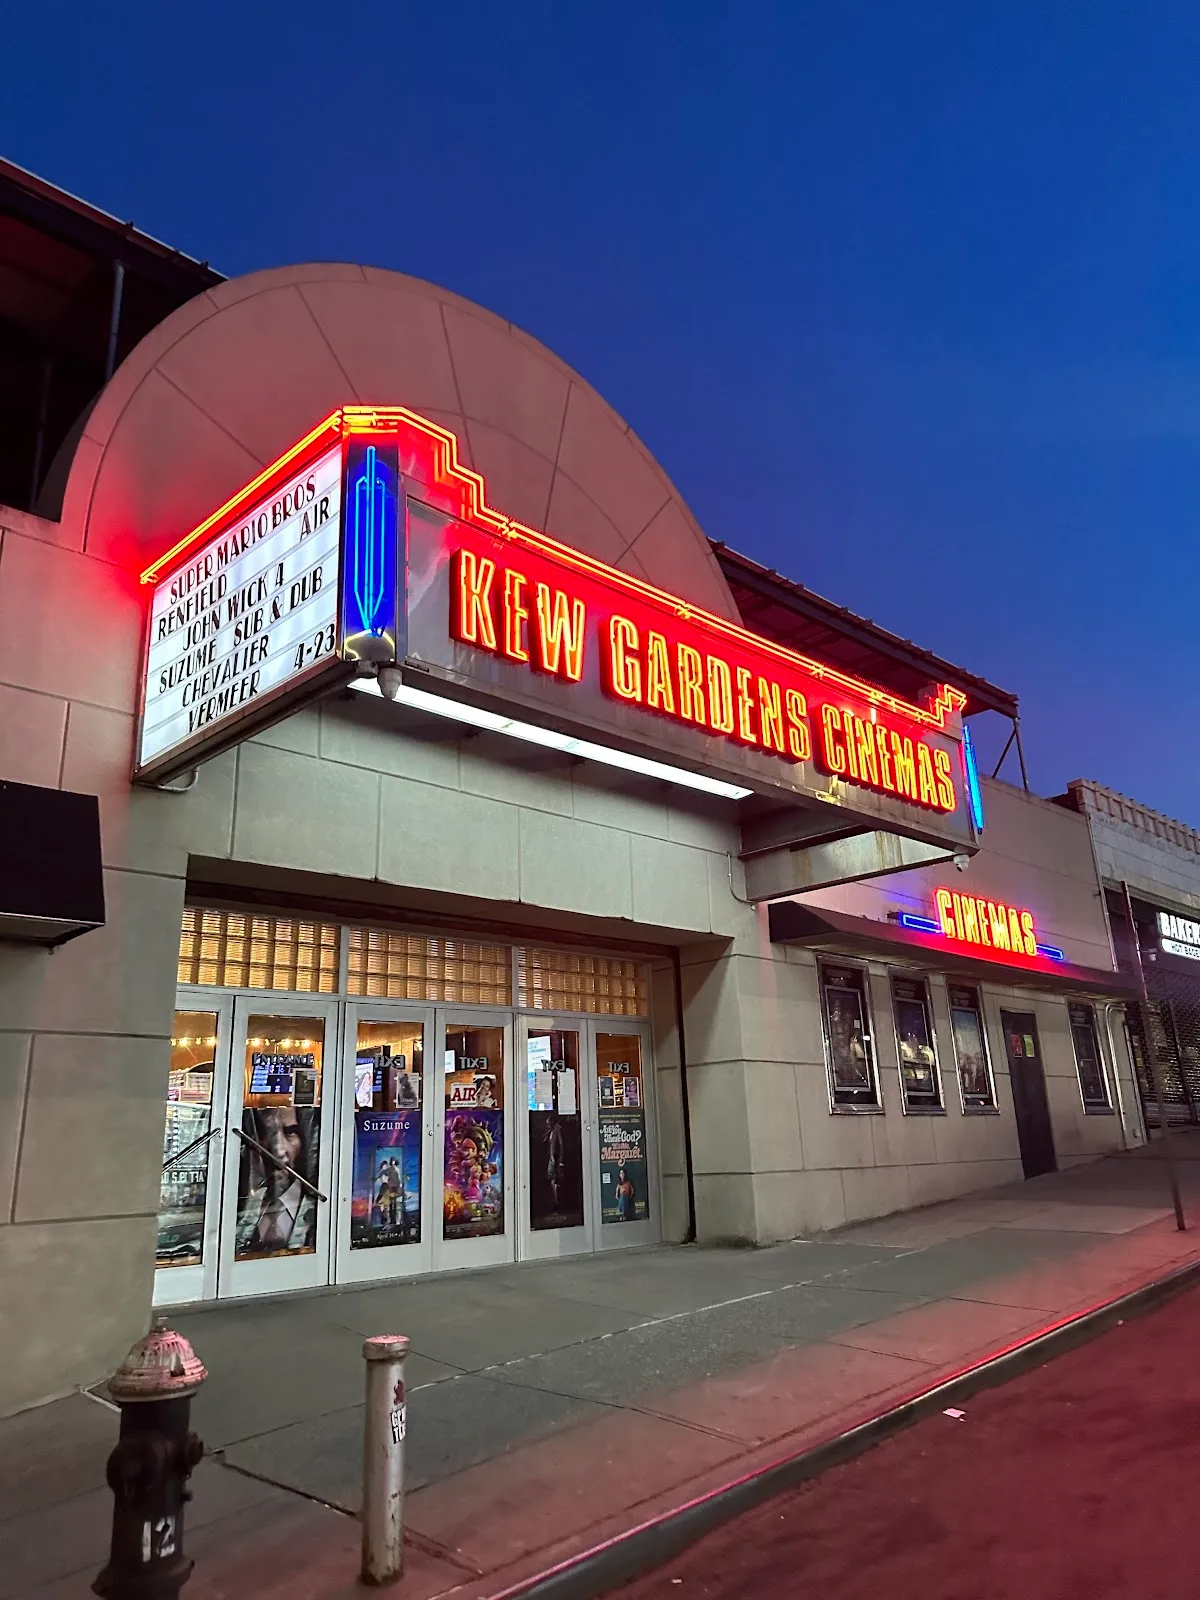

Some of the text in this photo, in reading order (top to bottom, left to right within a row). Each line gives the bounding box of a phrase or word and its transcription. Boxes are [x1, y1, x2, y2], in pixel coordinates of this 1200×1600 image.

[170, 474, 316, 605] SUPER MARIO BROS
[300, 496, 329, 542] AIR
[158, 573, 227, 641] RENFIELD
[182, 561, 284, 651] JOHN WICK 4
[159, 566, 323, 694] SUZUME SUB & DUB
[293, 623, 335, 670] 4-23
[182, 634, 269, 708] CHEVALIER
[453, 547, 958, 813] KEW GARDENS CINEMAS
[188, 669, 261, 733] VERMEER
[934, 888, 1037, 957] CINEMAS
[1159, 912, 1200, 946] BAKER
[252, 1052, 314, 1067] ENTRANCE
[451, 1087, 477, 1102] AIR
[363, 1120, 410, 1132] Suzume
[620, 1129, 642, 1146] God?
[601, 1146, 643, 1167] Margaret.
[142, 1515, 176, 1562] 12
